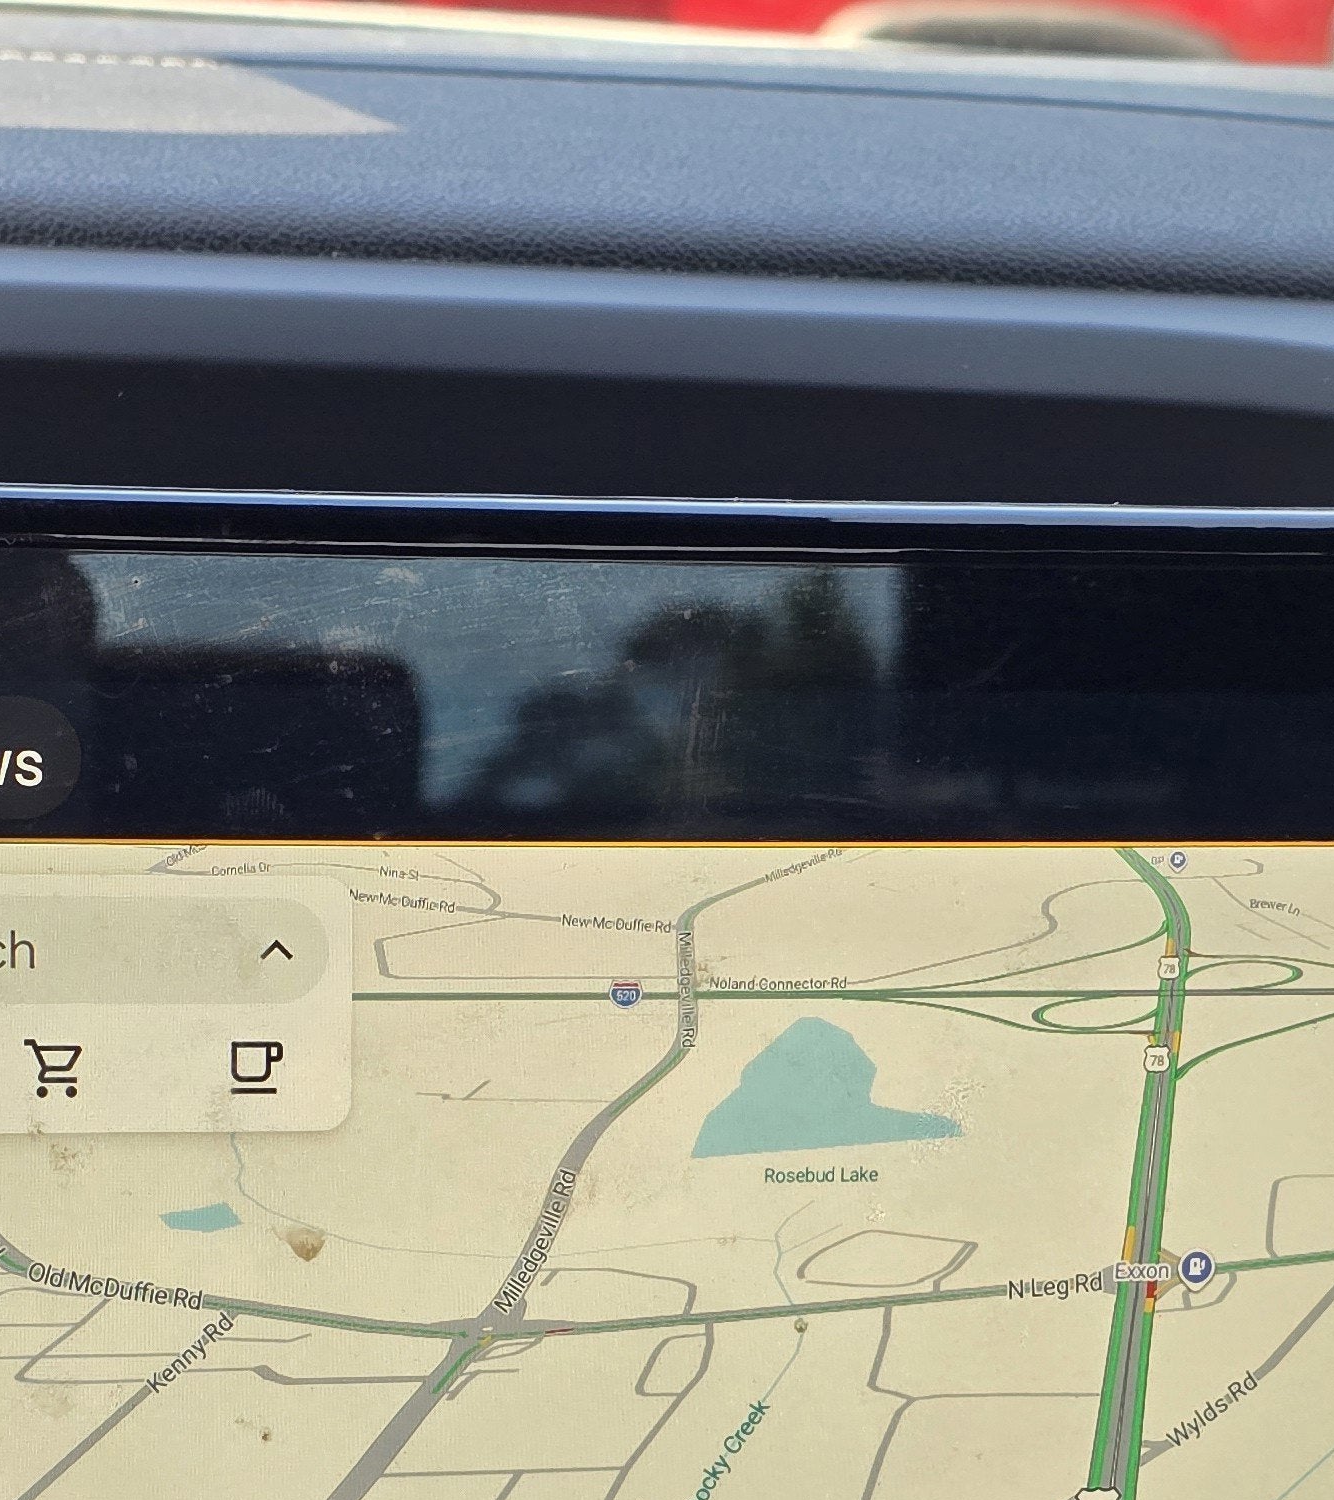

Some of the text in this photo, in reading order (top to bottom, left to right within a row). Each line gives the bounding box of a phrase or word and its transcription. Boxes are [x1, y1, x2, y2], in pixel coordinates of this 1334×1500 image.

[258, 861, 271, 873] Dr
[349, 888, 378, 903] New
[439, 900, 456, 913] Rd
[1249, 898, 1287, 911] Brewer
[561, 913, 590, 928] New
[654, 919, 672, 934] Rd
[1163, 963, 1176, 974] 78
[677, 931, 696, 1049] Milledgeville Rd
[709, 976, 848, 991] Noland Connector Rd
[1149, 1054, 1165, 1067] 78
[764, 1166, 879, 1183] Rosebud Lake
[493, 1168, 577, 1314] Milledgeville Rd
[1115, 1262, 1170, 1280] Exxon
[27, 1261, 203, 1311] Old McDuffie Rd
[1008, 1271, 1103, 1300] N Leg Rd
[146, 1312, 235, 1394] Kenny Rd
[1165, 1370, 1259, 1448] Wylds Rd
[723, 1399, 771, 1455] Creek
